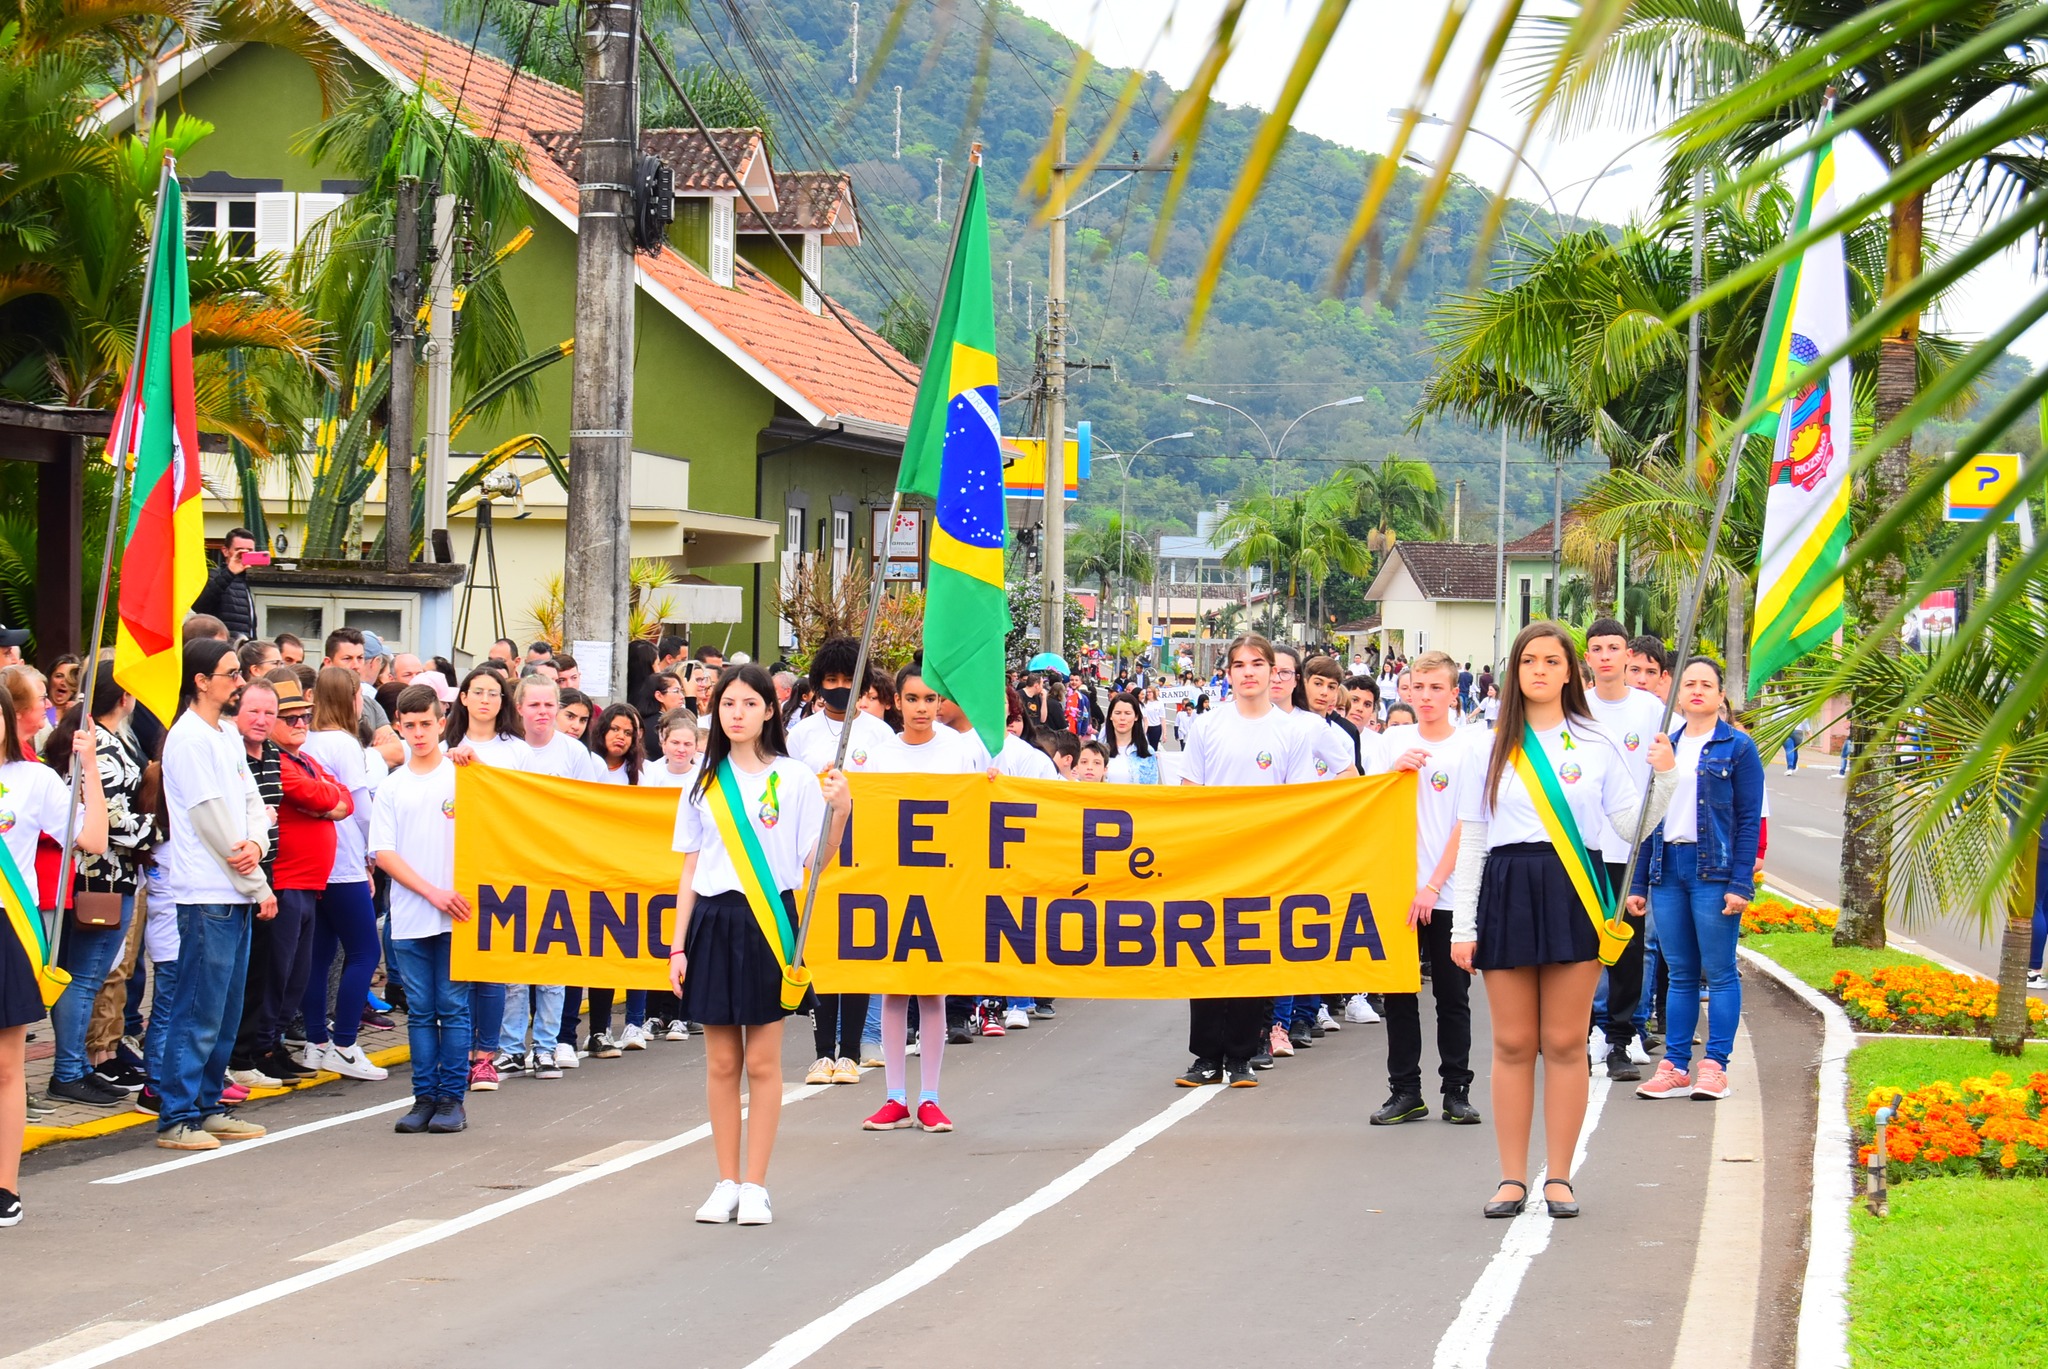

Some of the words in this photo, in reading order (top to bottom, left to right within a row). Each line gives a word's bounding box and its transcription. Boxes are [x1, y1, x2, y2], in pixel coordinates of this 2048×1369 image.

[966, 390, 1000, 434] ORDEM
[1794, 433, 1827, 476] RIOZINHO
[898, 799, 954, 868] E.
[989, 801, 1038, 869] F.
[1082, 808, 1163, 880] Pe.
[838, 893, 943, 962] DA
[985, 882, 1386, 967] NÓBREGA
